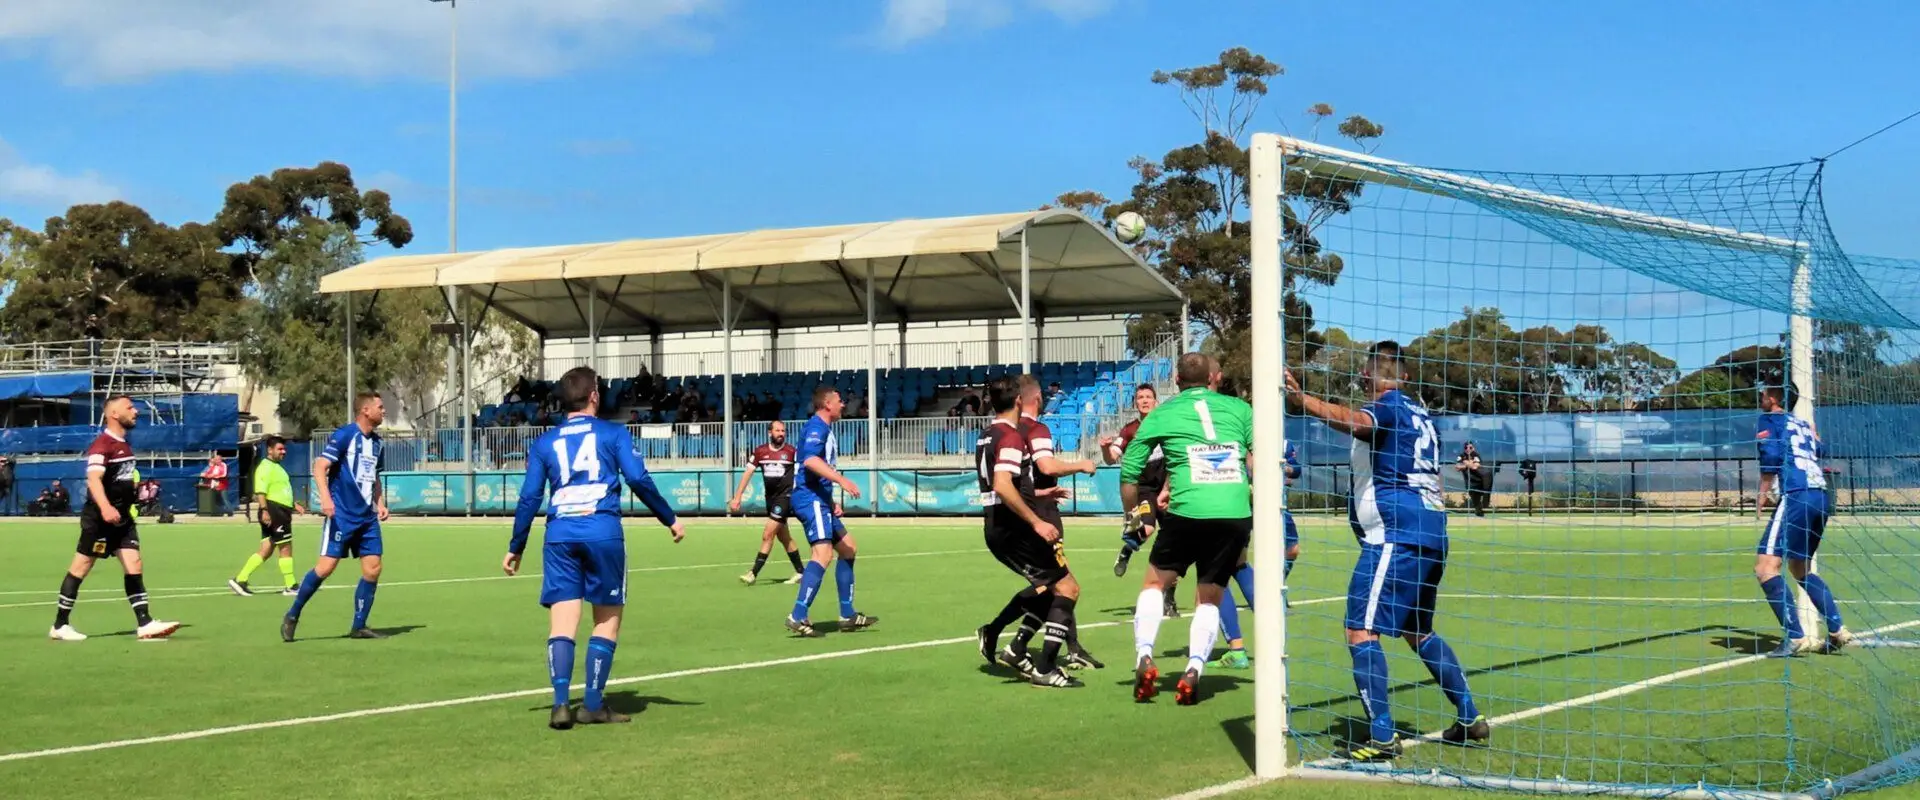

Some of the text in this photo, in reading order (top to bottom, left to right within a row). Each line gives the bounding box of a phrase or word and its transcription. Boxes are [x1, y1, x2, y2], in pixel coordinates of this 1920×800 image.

[1194, 400, 1217, 441] 1
[552, 432, 600, 486] 14
[335, 531, 342, 542] 6
